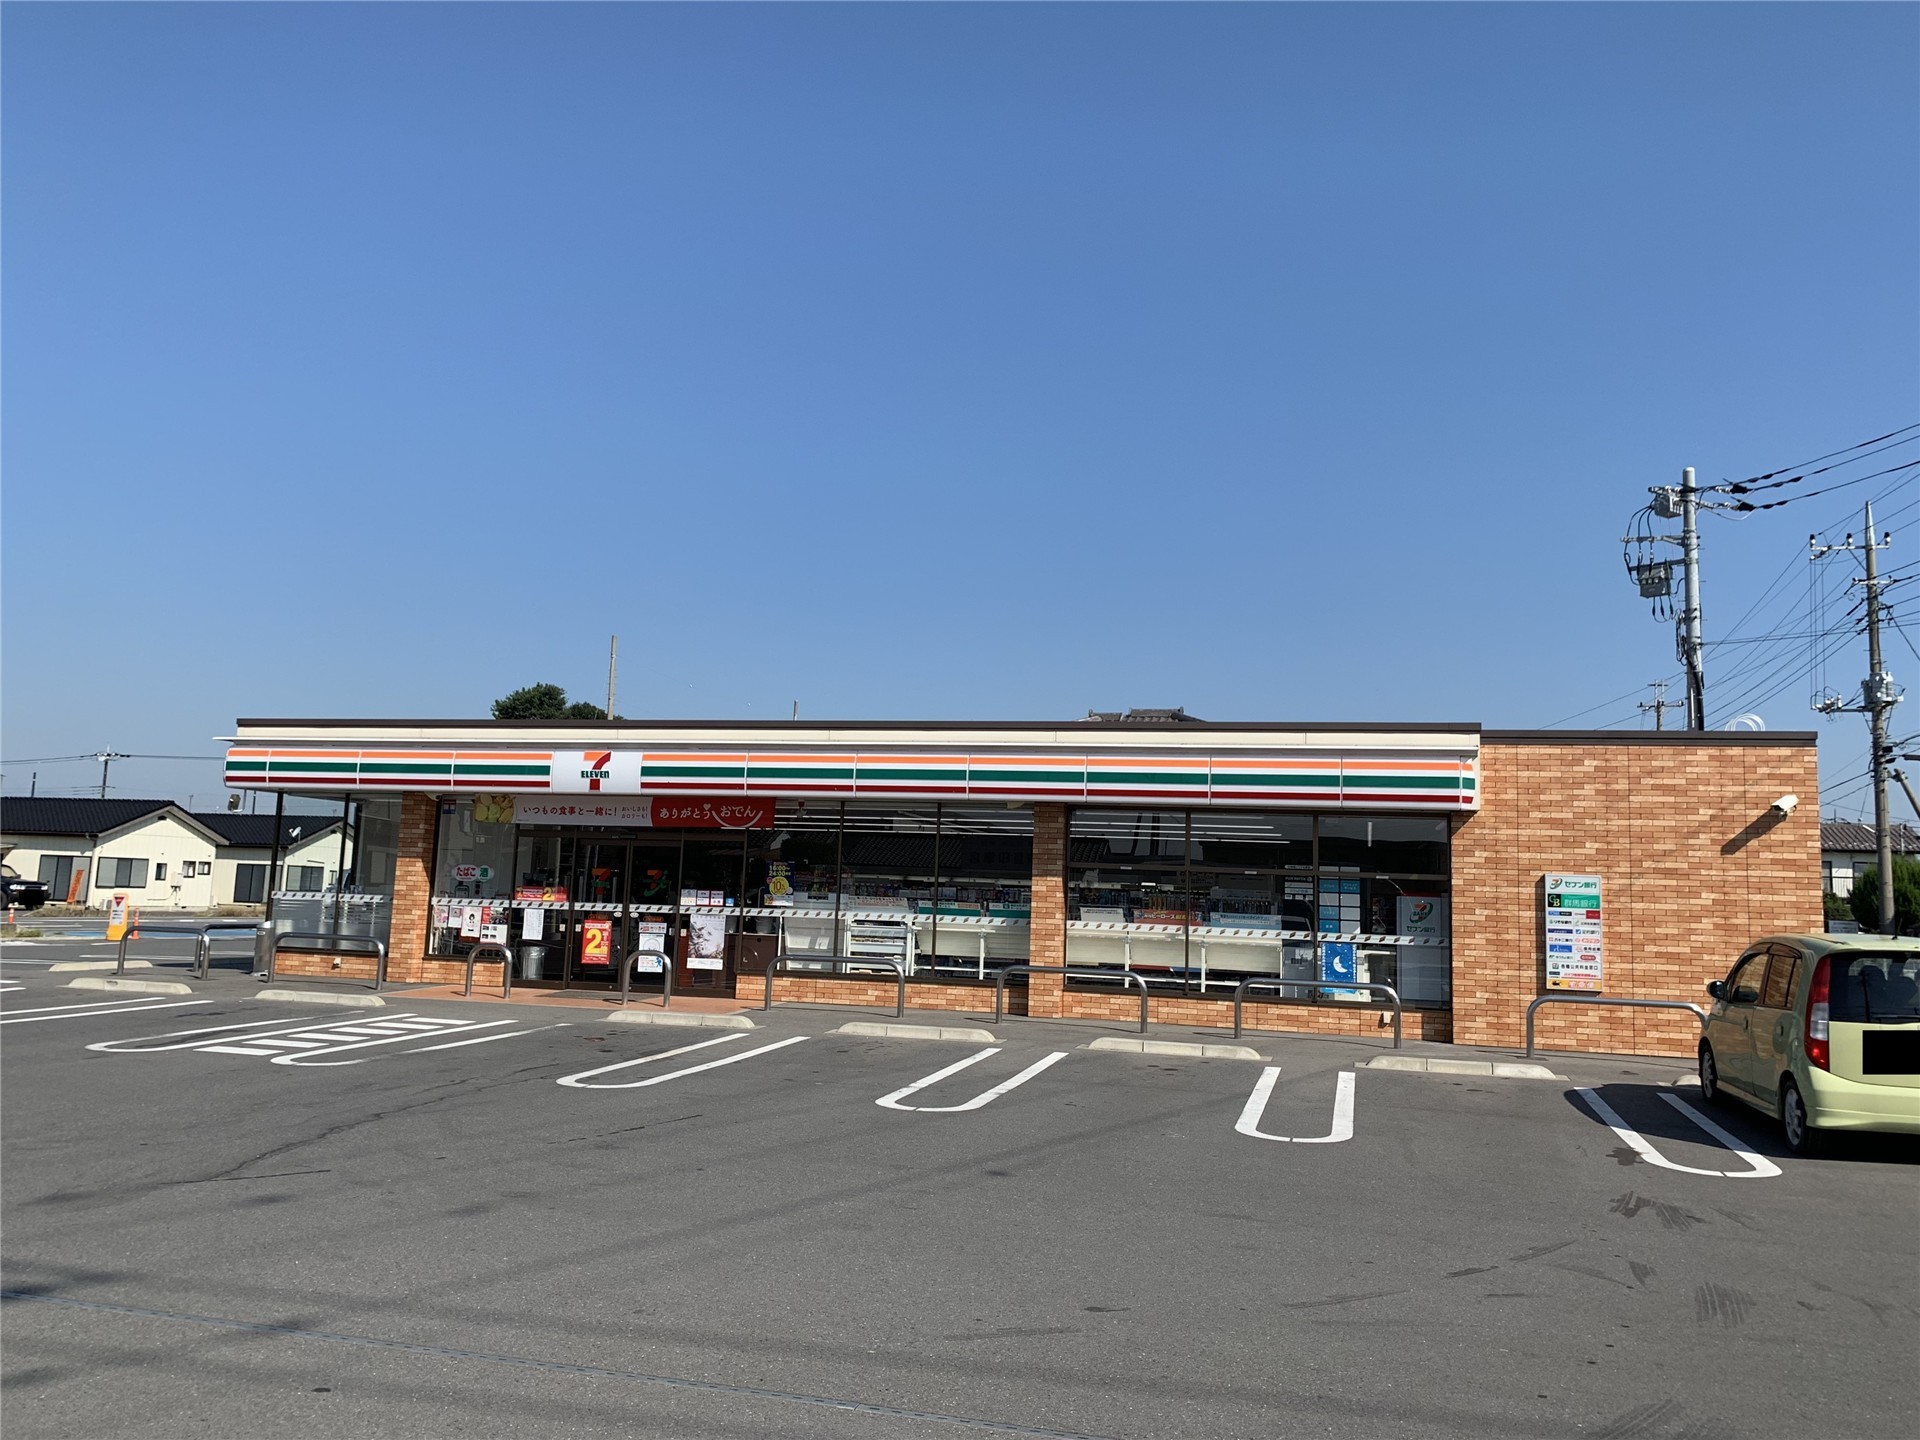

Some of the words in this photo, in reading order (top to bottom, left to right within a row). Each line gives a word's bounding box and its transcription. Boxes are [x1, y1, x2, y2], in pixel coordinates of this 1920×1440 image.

[583, 751, 611, 790] 7
[659, 807, 711, 819] ありがとう
[720, 805, 756, 817] おでん
[456, 867, 476, 877] たばこ
[480, 867, 489, 878] 酒
[1564, 881, 1597, 889] セブン銀行
[1564, 899, 1597, 908] 群馬銀行
[584, 928, 603, 954] 2
